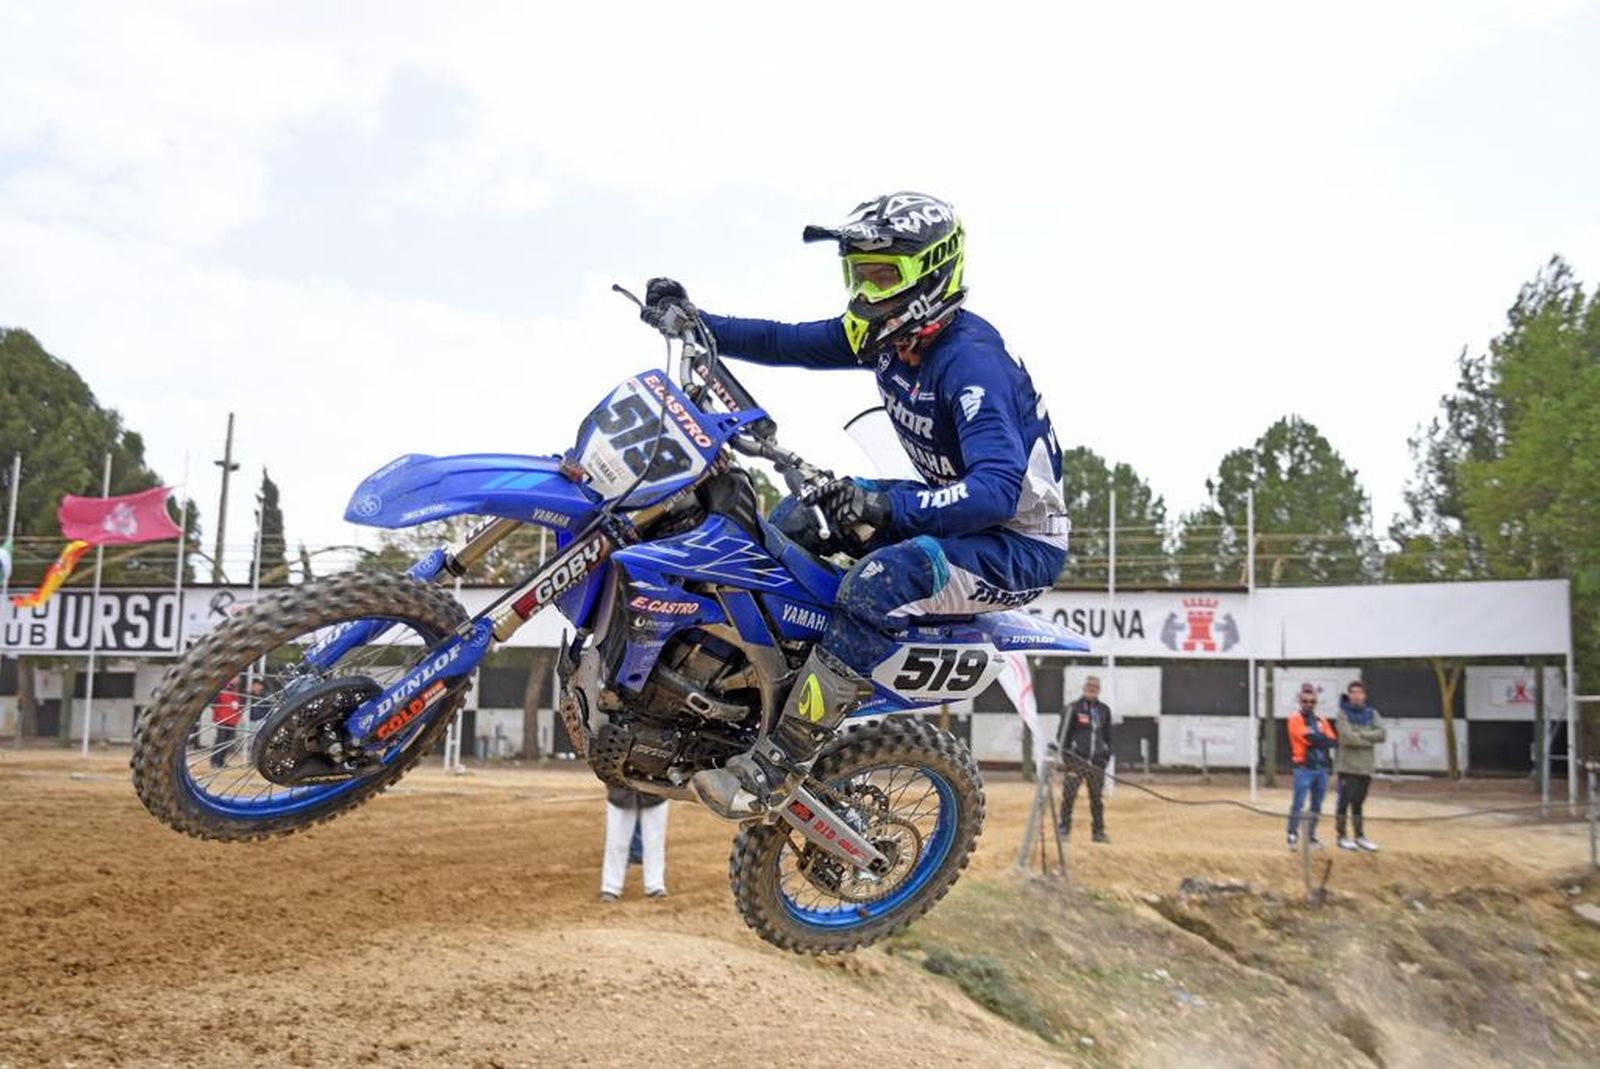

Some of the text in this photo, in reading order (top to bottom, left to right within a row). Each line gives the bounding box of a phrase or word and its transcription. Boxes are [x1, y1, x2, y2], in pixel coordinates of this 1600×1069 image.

[594, 393, 694, 483] 519
[531, 507, 571, 528] YAMAHA
[535, 538, 602, 605] GOBY
[63, 593, 180, 649] URSO
[630, 595, 699, 615] E.CASTRO
[1011, 635, 1056, 644] DUNLOP
[893, 647, 989, 692] 519
